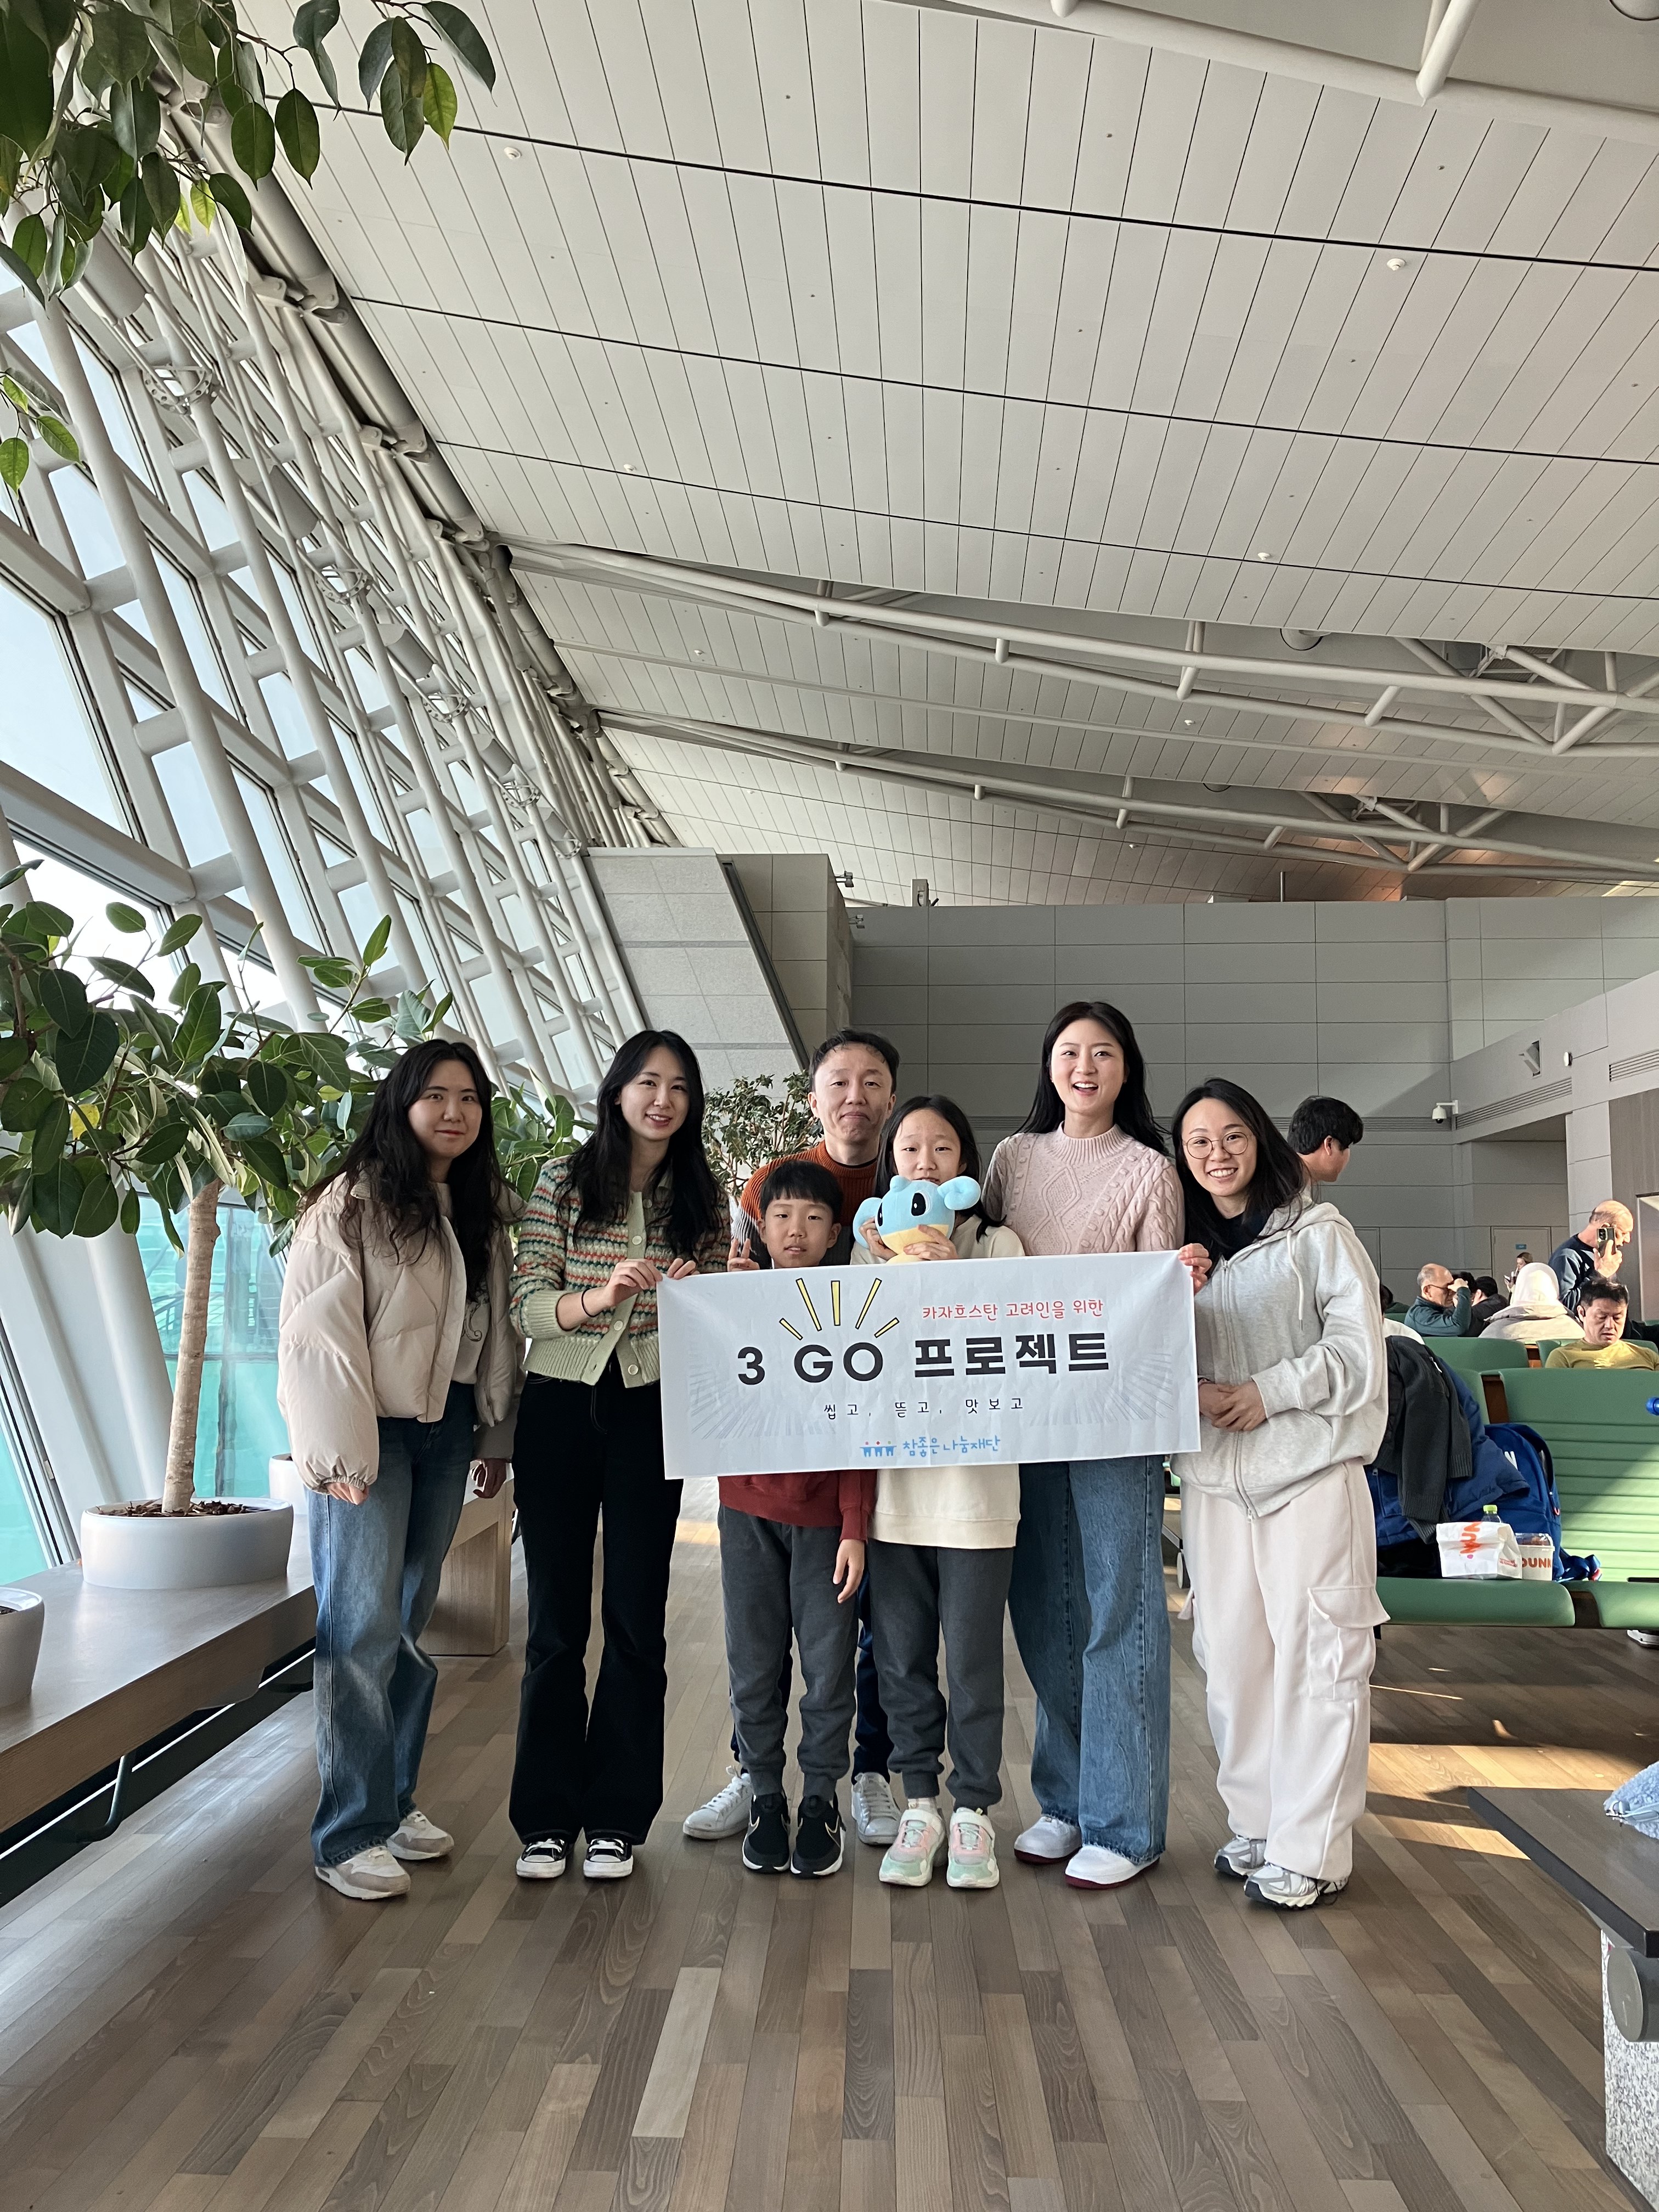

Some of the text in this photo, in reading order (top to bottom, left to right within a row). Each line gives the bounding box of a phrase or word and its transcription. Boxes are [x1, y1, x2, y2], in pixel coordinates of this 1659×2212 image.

[923, 1299, 1103, 1321] 카자흐스탄 고려인을 위한
[737, 1333, 1109, 1385] 3 GO 프로젝트
[966, 1398, 1023, 1414] 맛보고
